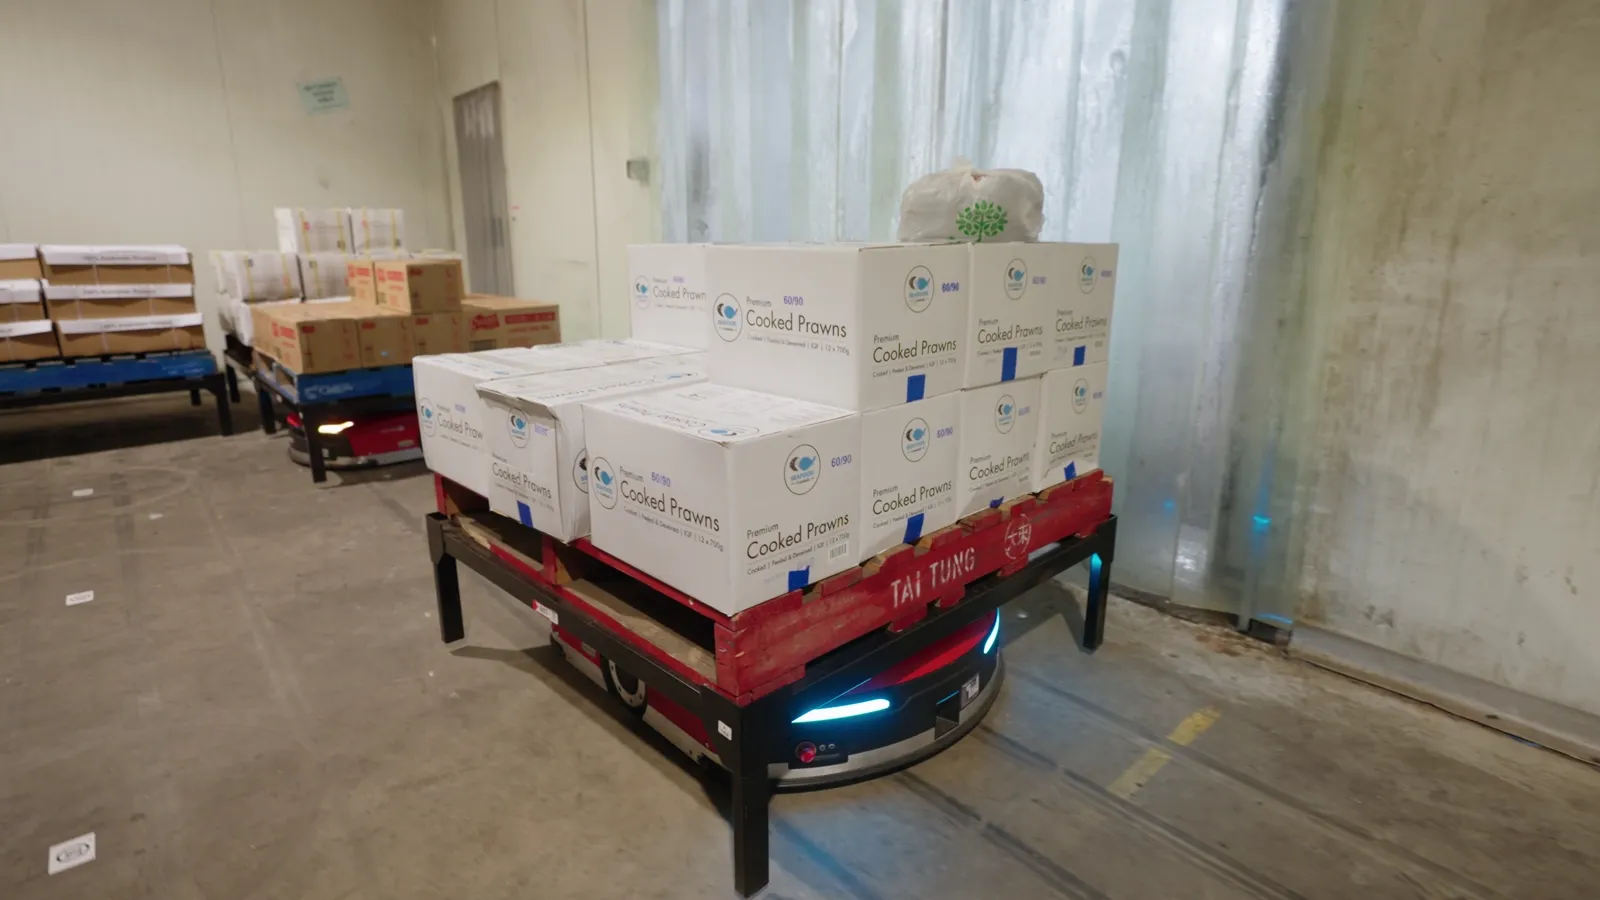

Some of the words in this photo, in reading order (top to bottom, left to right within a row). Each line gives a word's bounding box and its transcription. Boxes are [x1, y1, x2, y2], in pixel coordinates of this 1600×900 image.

[653, 286, 681, 299] Cooked
[683, 287, 706, 301] Prawn
[746, 296, 772, 307] Premium
[783, 295, 804, 306] 60/90
[746, 309, 793, 331] Cooked
[797, 314, 847, 338] Prawns
[977, 323, 1013, 344] Cooked
[1015, 324, 1043, 339] Prawns
[873, 334, 899, 344] Premium
[873, 340, 918, 363] Cooked
[921, 340, 957, 356] Prawns
[465, 421, 484, 440] Praw
[831, 454, 852, 468] 60/90
[969, 457, 1005, 480] Cooked
[492, 462, 521, 486] Cooked
[523, 474, 552, 499] Prawns
[651, 472, 672, 488] 60/90
[872, 485, 899, 498] Premium
[872, 487, 917, 515] Cooked
[919, 480, 952, 501] Prawns
[620, 480, 665, 512] Cooked
[669, 497, 720, 532] Prawns
[746, 524, 802, 559] Cooked
[807, 514, 850, 540] Prawns
[747, 523, 779, 540] Premium
[891, 570, 921, 609] TAI
[929, 546, 975, 588] TUNG
